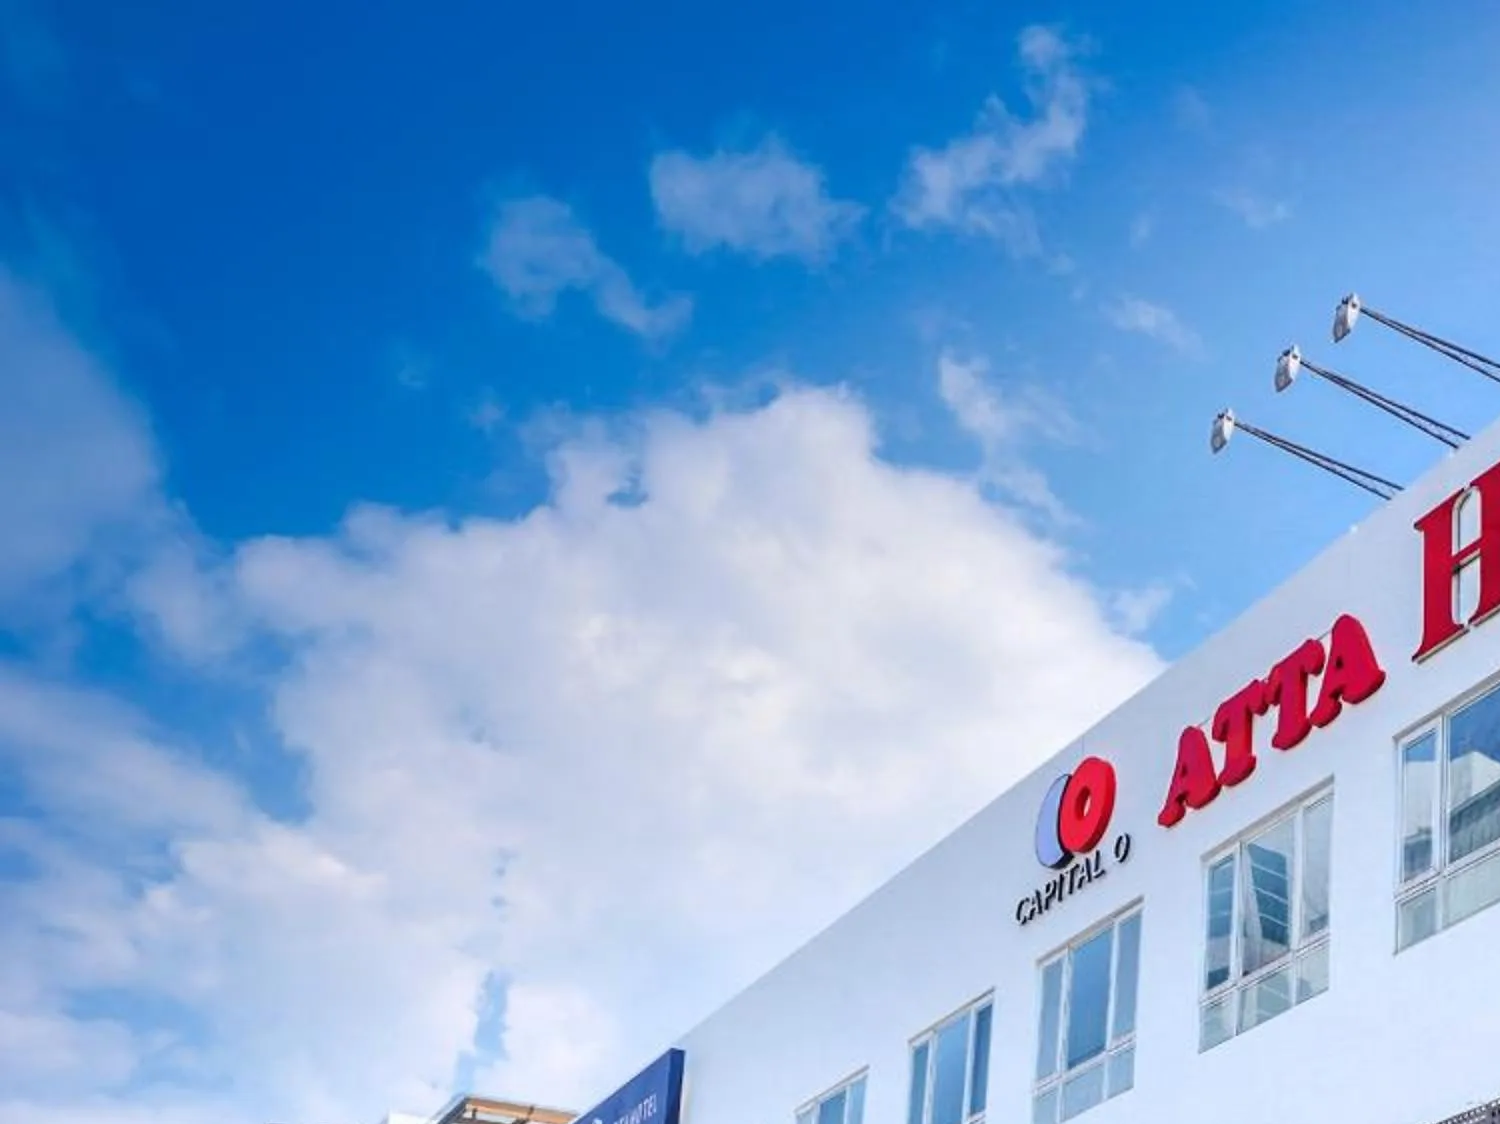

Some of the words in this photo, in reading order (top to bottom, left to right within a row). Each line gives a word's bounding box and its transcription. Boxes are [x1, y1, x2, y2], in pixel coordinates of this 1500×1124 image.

[1157, 614, 1386, 827] ATTA
[1015, 850, 1106, 926] CAPITAL
[1114, 832, 1131, 863] O
